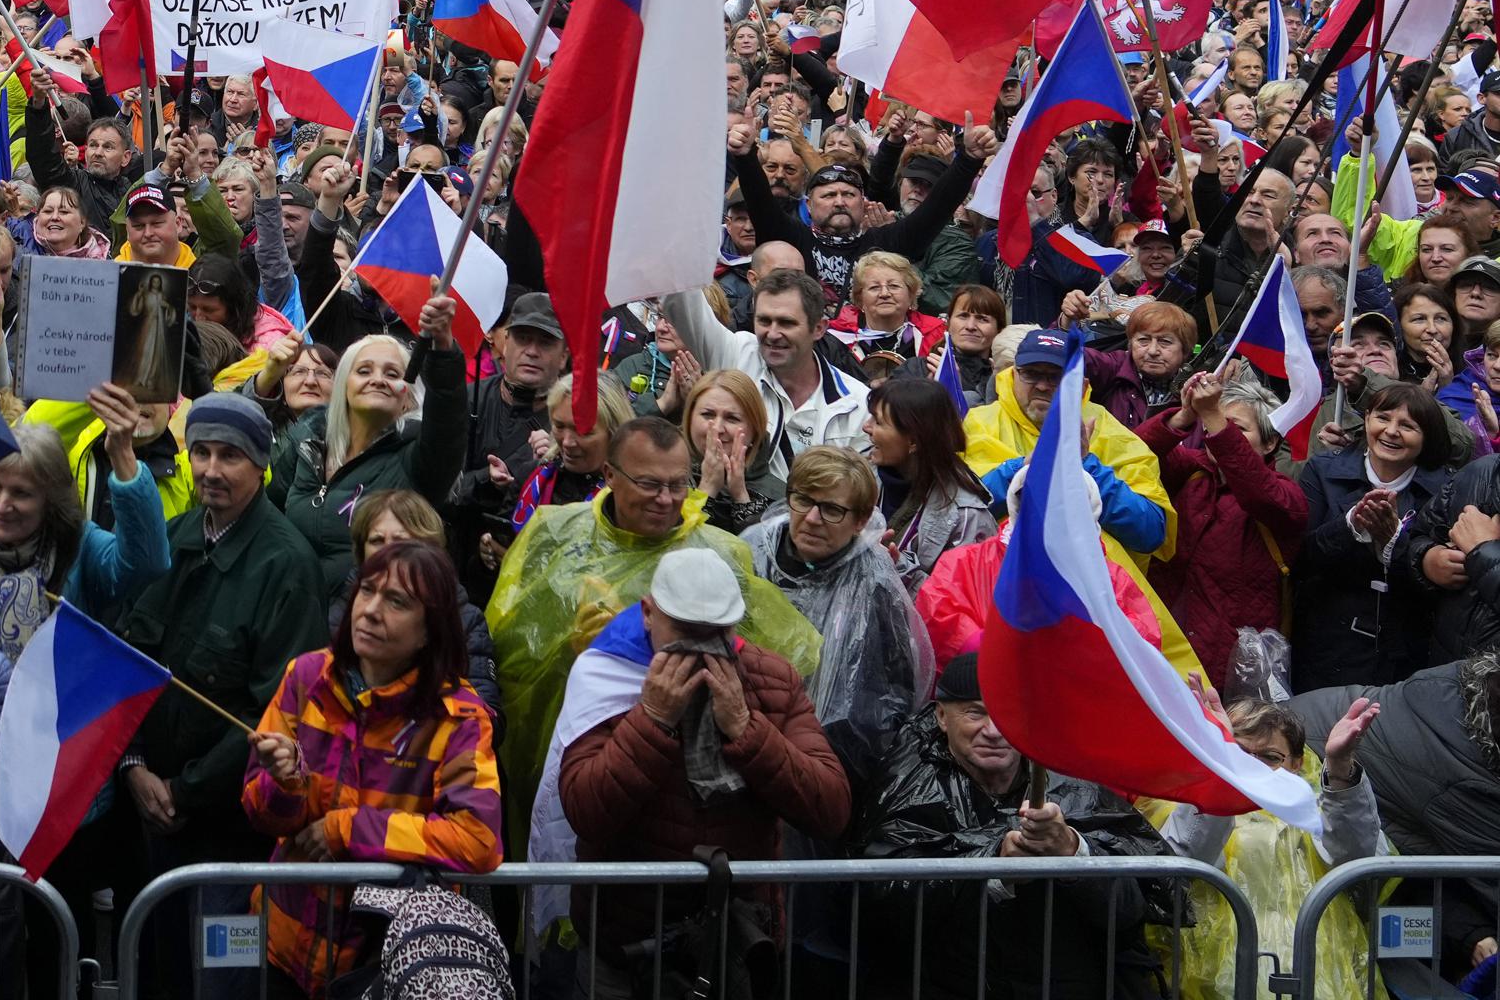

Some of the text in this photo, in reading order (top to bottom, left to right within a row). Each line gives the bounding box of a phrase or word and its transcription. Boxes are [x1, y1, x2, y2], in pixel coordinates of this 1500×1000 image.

[177, 17, 260, 48] DRŽKOU
[42, 273, 68, 285] Praví
[71, 275, 105, 287] Kristus
[41, 290, 61, 301] Bůh
[73, 292, 96, 304] Pán:
[76, 330, 113, 342] národe
[53, 347, 77, 357] tebe
[1403, 917, 1432, 928] ČESKÉ
